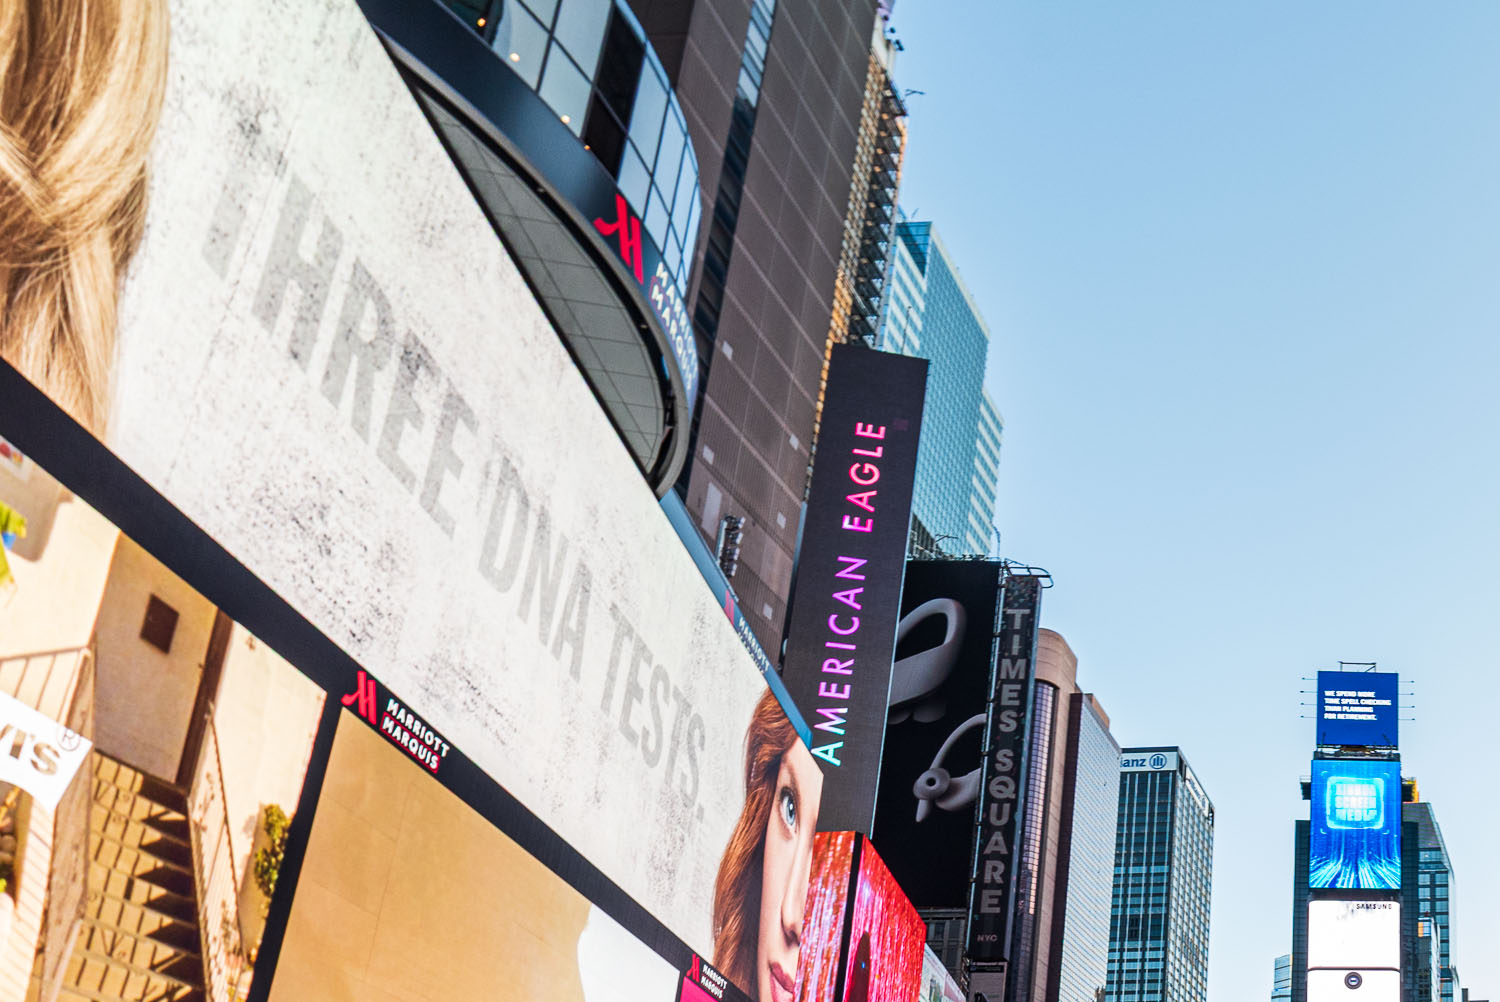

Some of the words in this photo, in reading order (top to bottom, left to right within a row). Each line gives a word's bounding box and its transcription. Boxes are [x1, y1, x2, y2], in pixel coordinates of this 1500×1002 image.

[477, 440, 593, 683] DNA
[600, 603, 706, 805] TESTS
[811, 555, 868, 767] AMERICAN
[843, 421, 887, 533] EAGLE
[999, 608, 1030, 733] TIMES
[382, 716, 439, 770] MARQUIS
[387, 698, 450, 758] MARRIOTT
[980, 749, 1016, 914] SQUARE
[977, 934, 998, 942] NYC
[701, 975, 724, 999] MARQUIS
[702, 964, 728, 990] MARRIOTT
